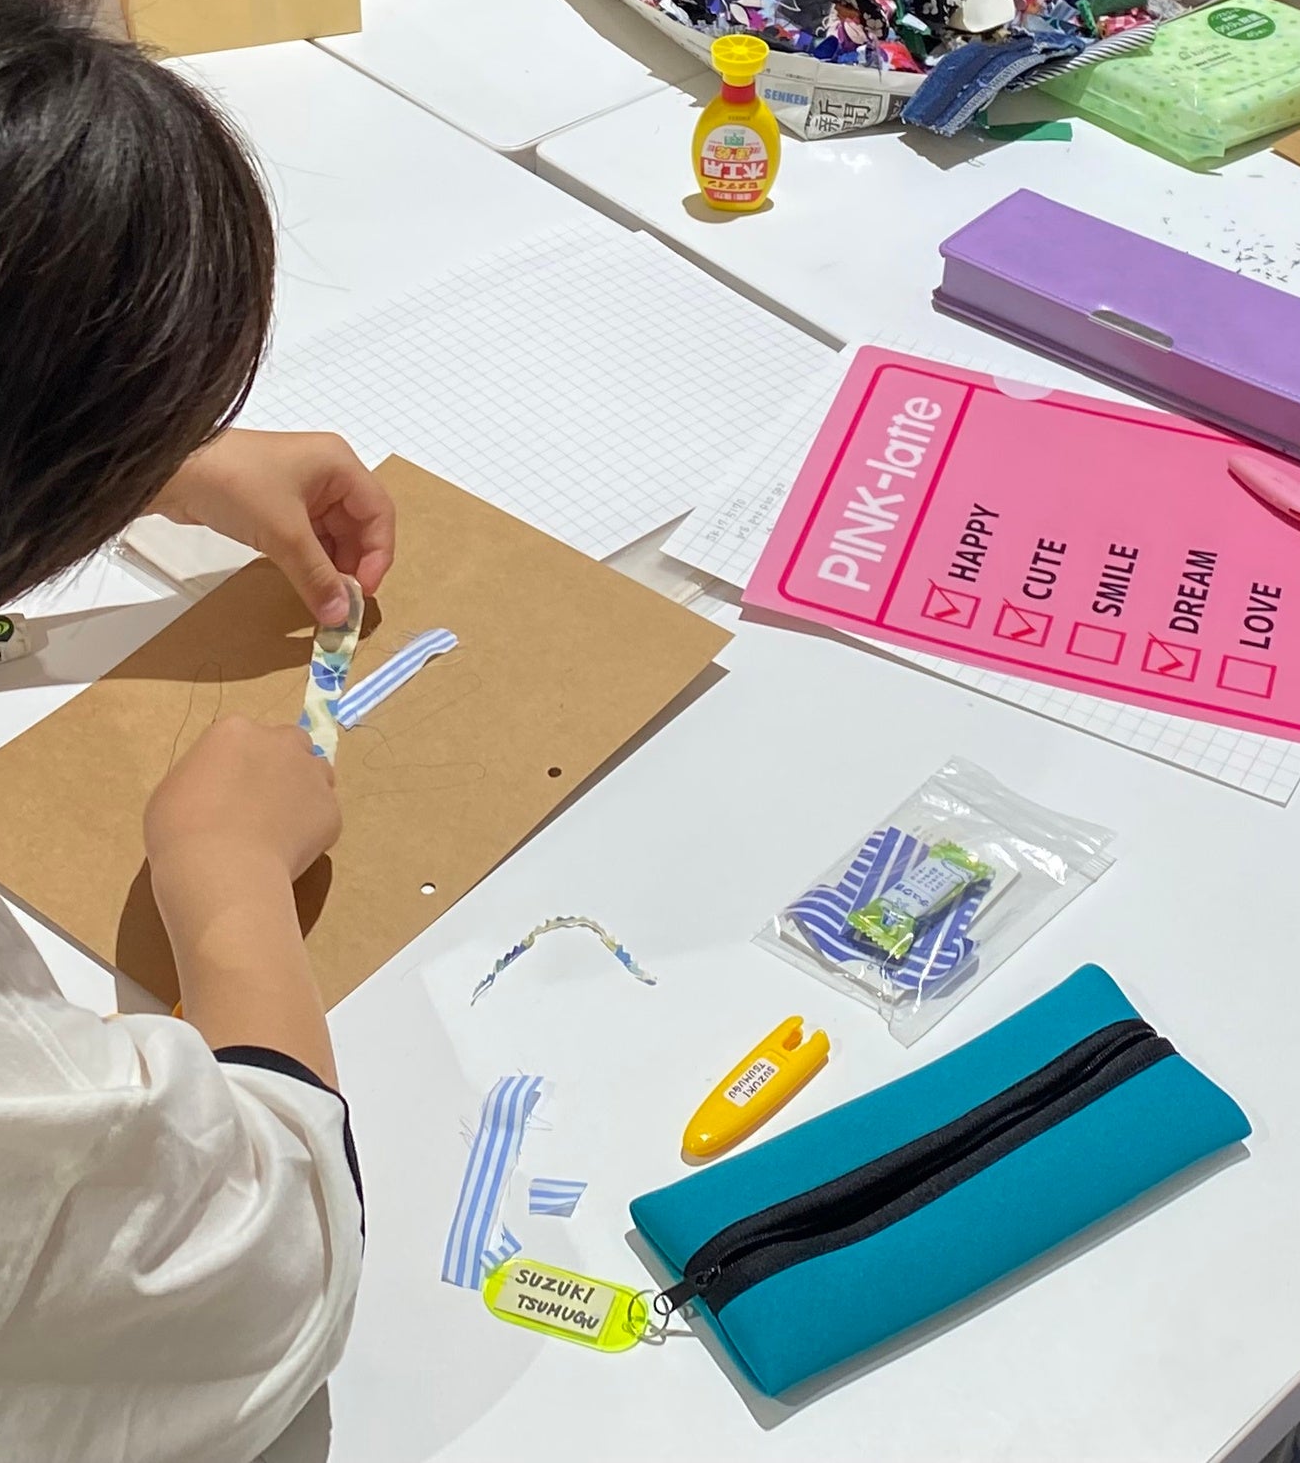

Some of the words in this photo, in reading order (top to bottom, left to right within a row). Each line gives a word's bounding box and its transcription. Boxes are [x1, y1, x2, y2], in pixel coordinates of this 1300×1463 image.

[764, 88, 809, 106] SENKEN
[703, 159, 764, 179] 木工用
[818, 395, 942, 592] PINK-latte
[948, 503, 999, 583] HAPPY
[1022, 538, 1067, 600] CUTE
[1092, 543, 1139, 617] SMILE
[1168, 549, 1218, 635] DREAM
[1239, 582, 1282, 650] LOVE
[728, 1061, 766, 1099] TSUMUGU
[742, 1065, 776, 1098] SUZUKI
[515, 1269, 596, 1304] SUZUKI
[518, 1293, 600, 1329] TSUMUGU
